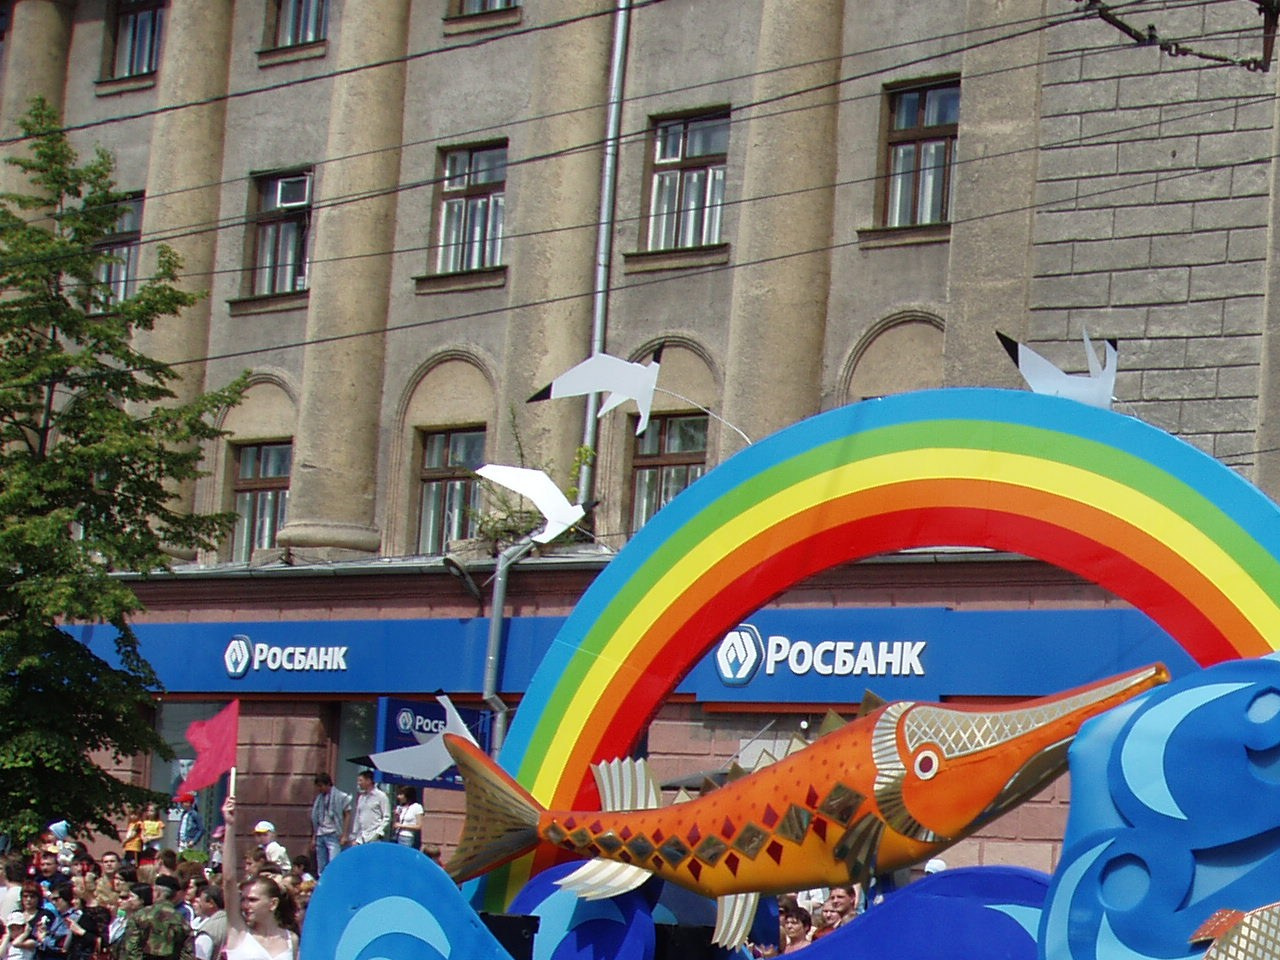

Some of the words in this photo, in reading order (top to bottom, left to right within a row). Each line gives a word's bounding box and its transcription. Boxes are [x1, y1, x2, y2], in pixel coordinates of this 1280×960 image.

[252, 642, 349, 671] РОСБАНК
[765, 635, 926, 676] РОСБАНК
[415, 714, 446, 733] РОСБ
